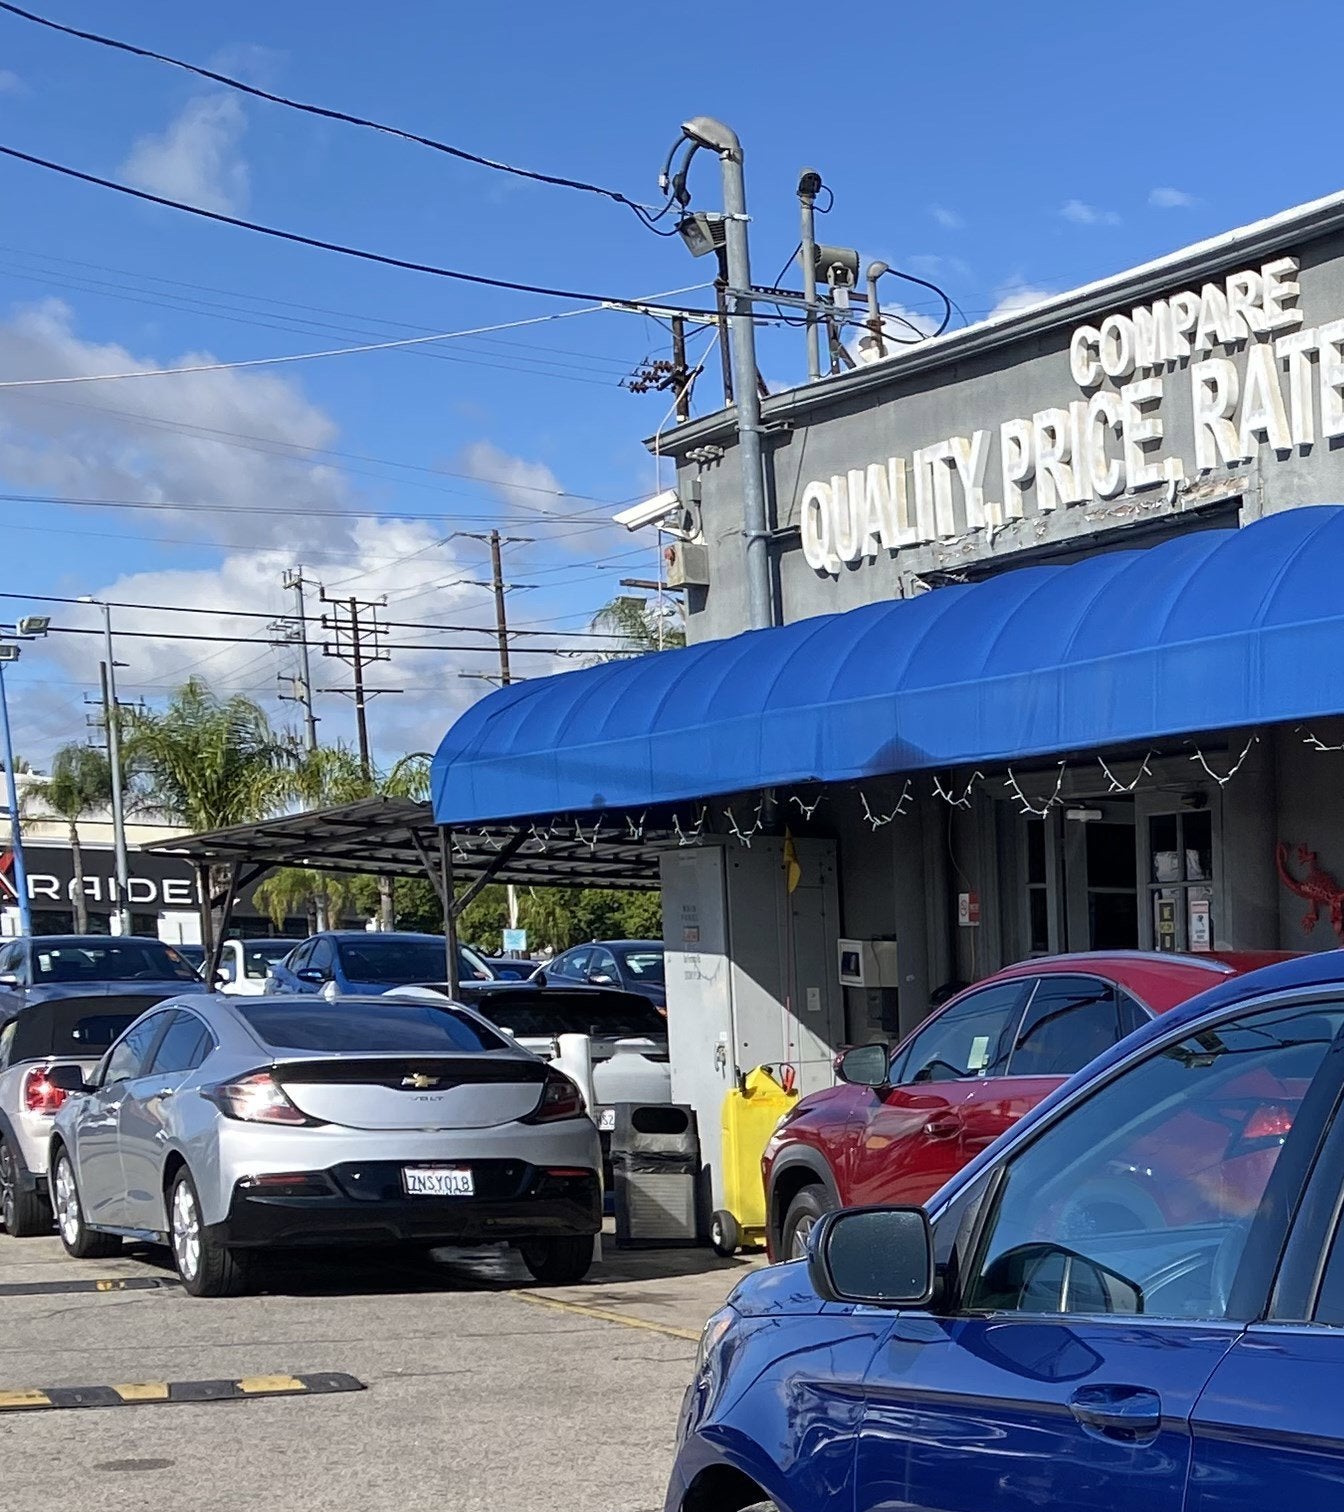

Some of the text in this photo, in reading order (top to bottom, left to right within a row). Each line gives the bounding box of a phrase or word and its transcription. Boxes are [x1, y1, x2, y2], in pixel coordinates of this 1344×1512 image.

[1070, 256, 1303, 387] COMPARE
[801, 430, 1000, 574] QUALITY,
[1001, 378, 1184, 519] PRICE,
[26, 873, 204, 904] RAIDE
